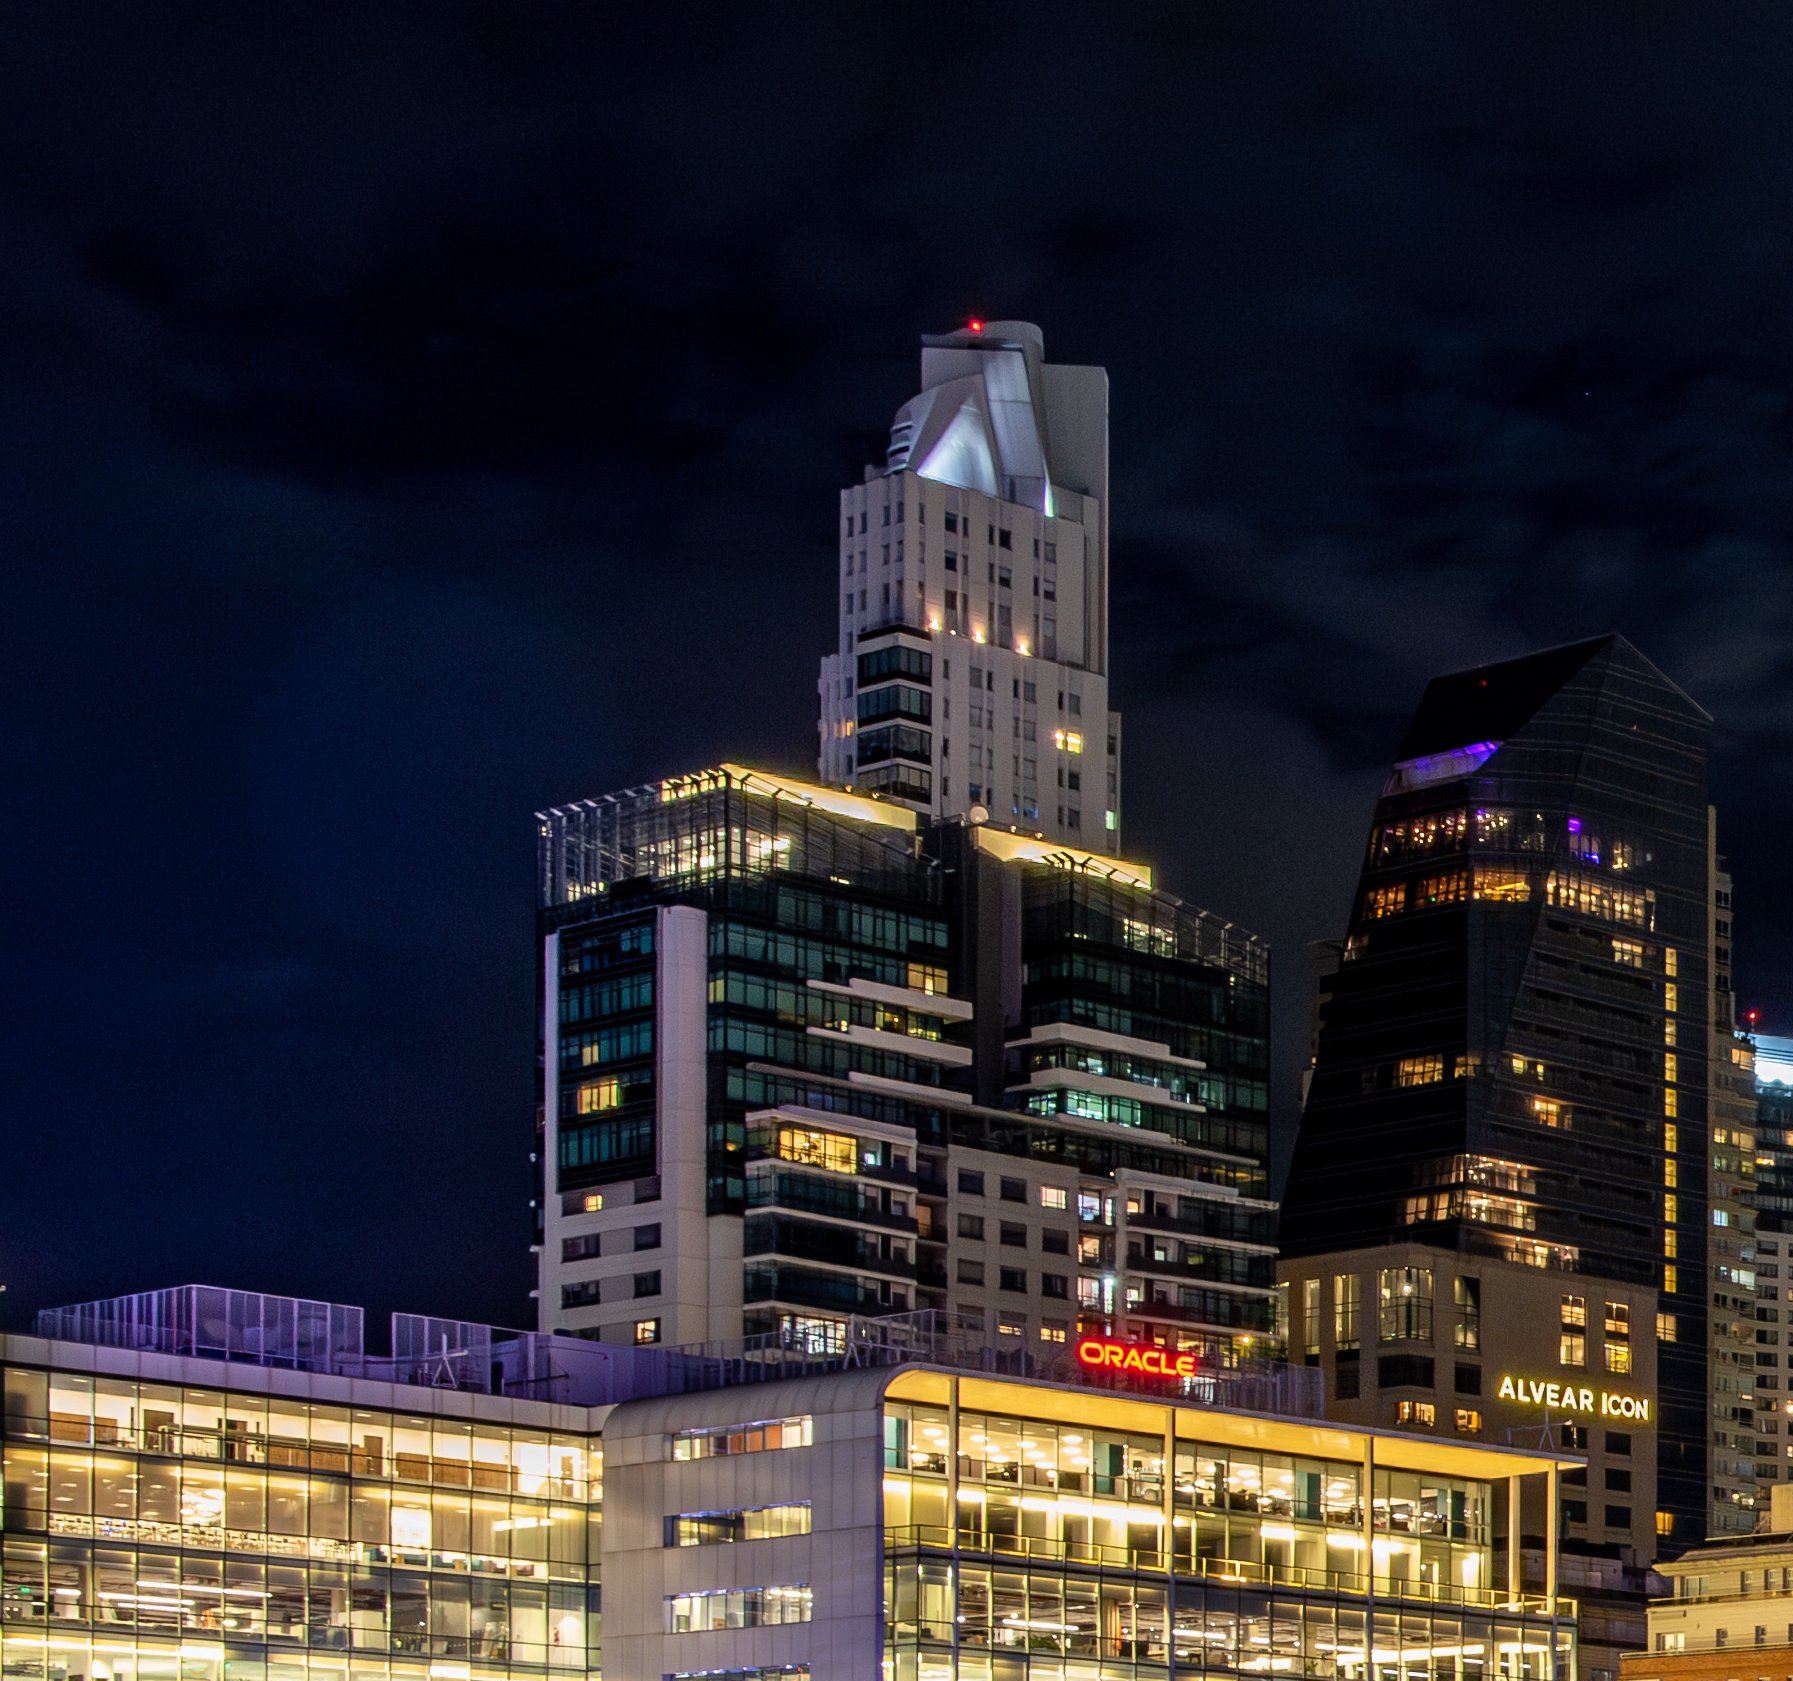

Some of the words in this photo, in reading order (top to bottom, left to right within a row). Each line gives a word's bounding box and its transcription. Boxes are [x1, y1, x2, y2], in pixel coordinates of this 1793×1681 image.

[1079, 1341, 1195, 1377] ORACLE
[1498, 1375, 1594, 1413] ALVEAR
[1600, 1390, 1649, 1421] ICON
